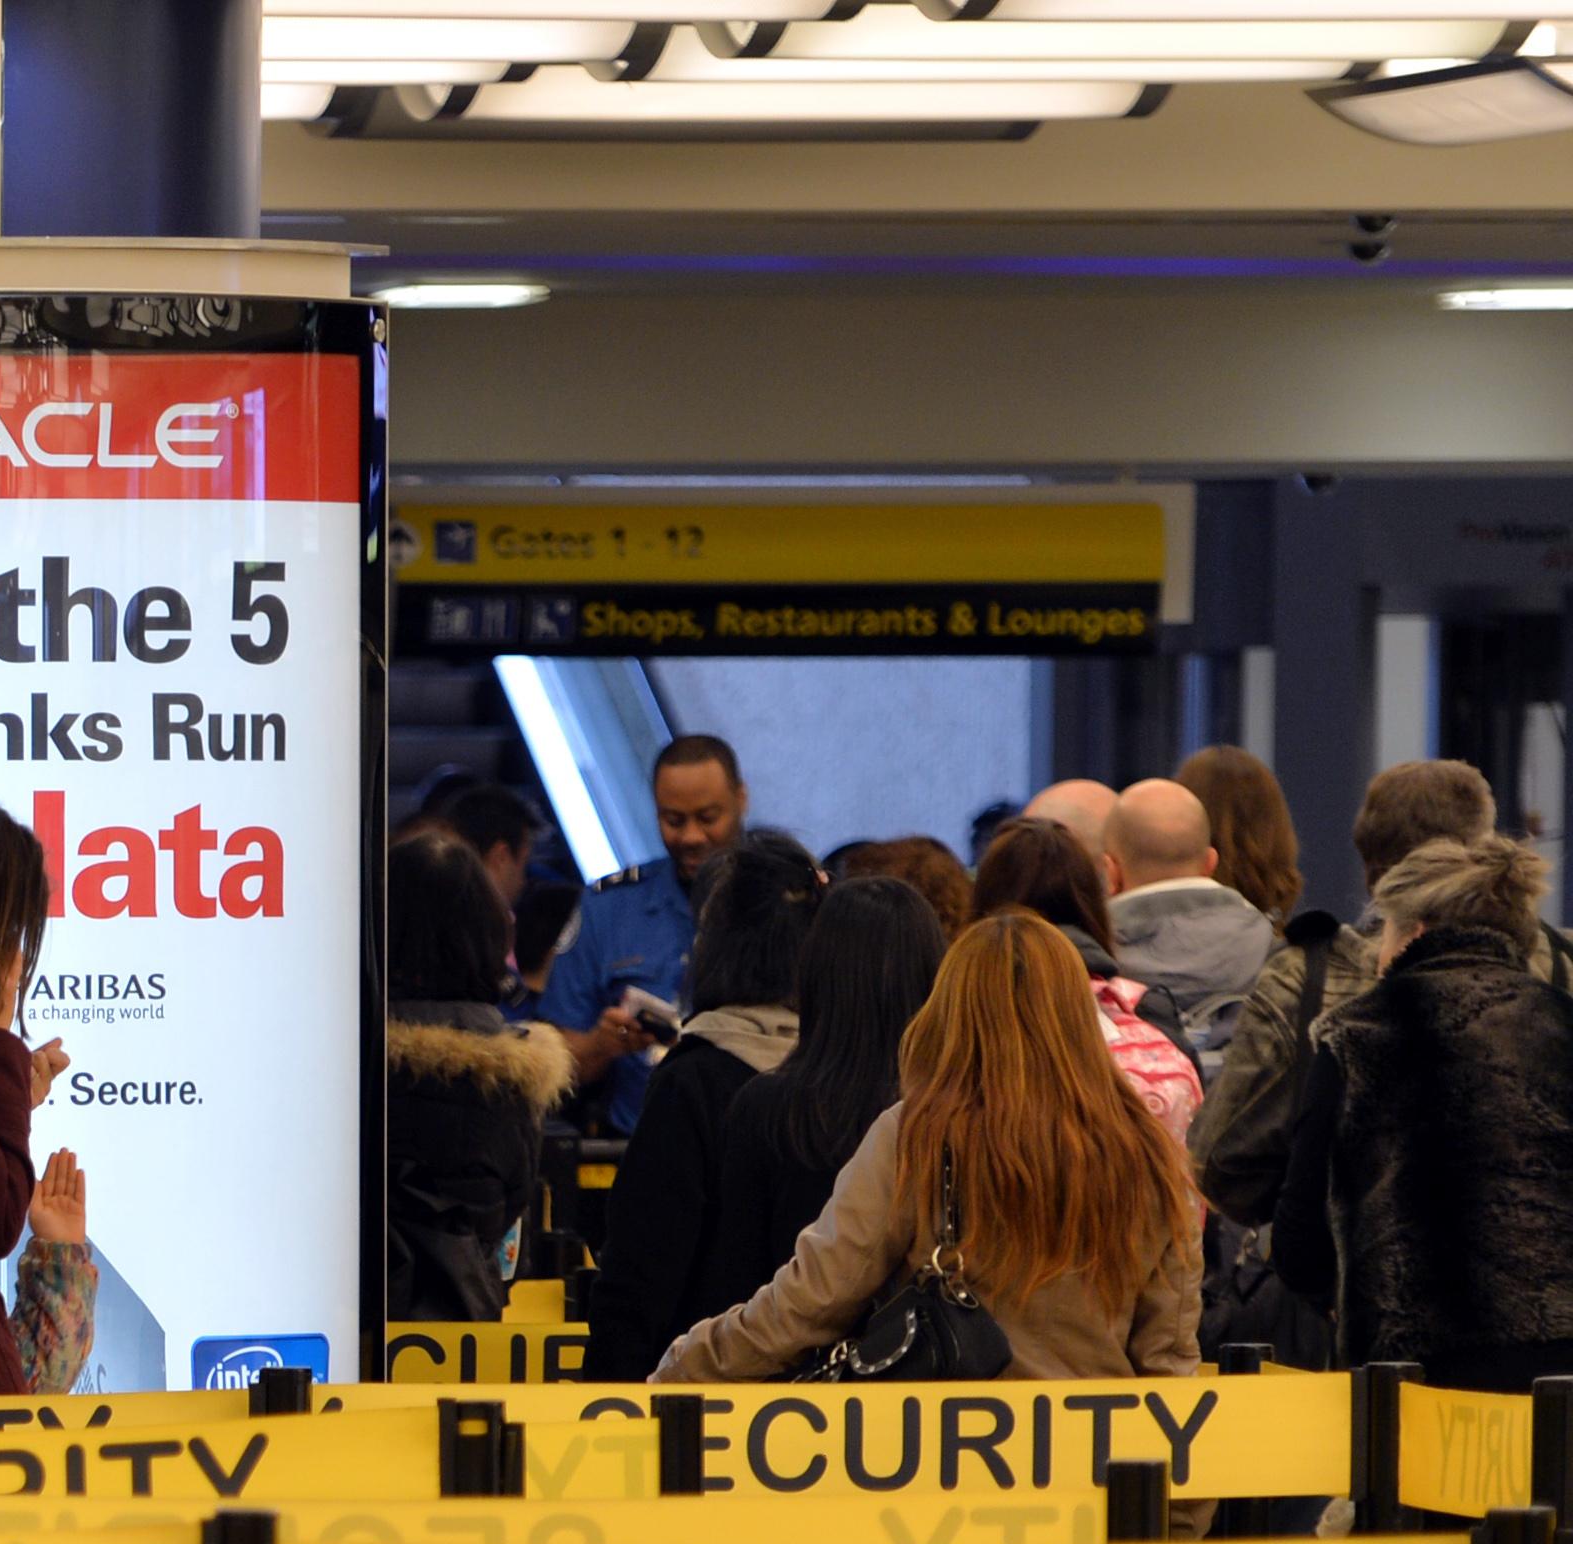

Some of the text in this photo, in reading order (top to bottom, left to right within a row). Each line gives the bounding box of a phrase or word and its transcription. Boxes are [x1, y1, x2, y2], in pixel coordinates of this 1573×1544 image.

[490, 524, 597, 561] Gates
[666, 525, 706, 559] 12
[229, 561, 289, 666] 5
[714, 602, 939, 638] Restaurants
[948, 601, 978, 637] &
[988, 602, 1146, 644] Lounges
[153, 692, 287, 762] Run
[28, 1005, 165, 1024] a changing world
[69, 1072, 203, 1106] Secure.
